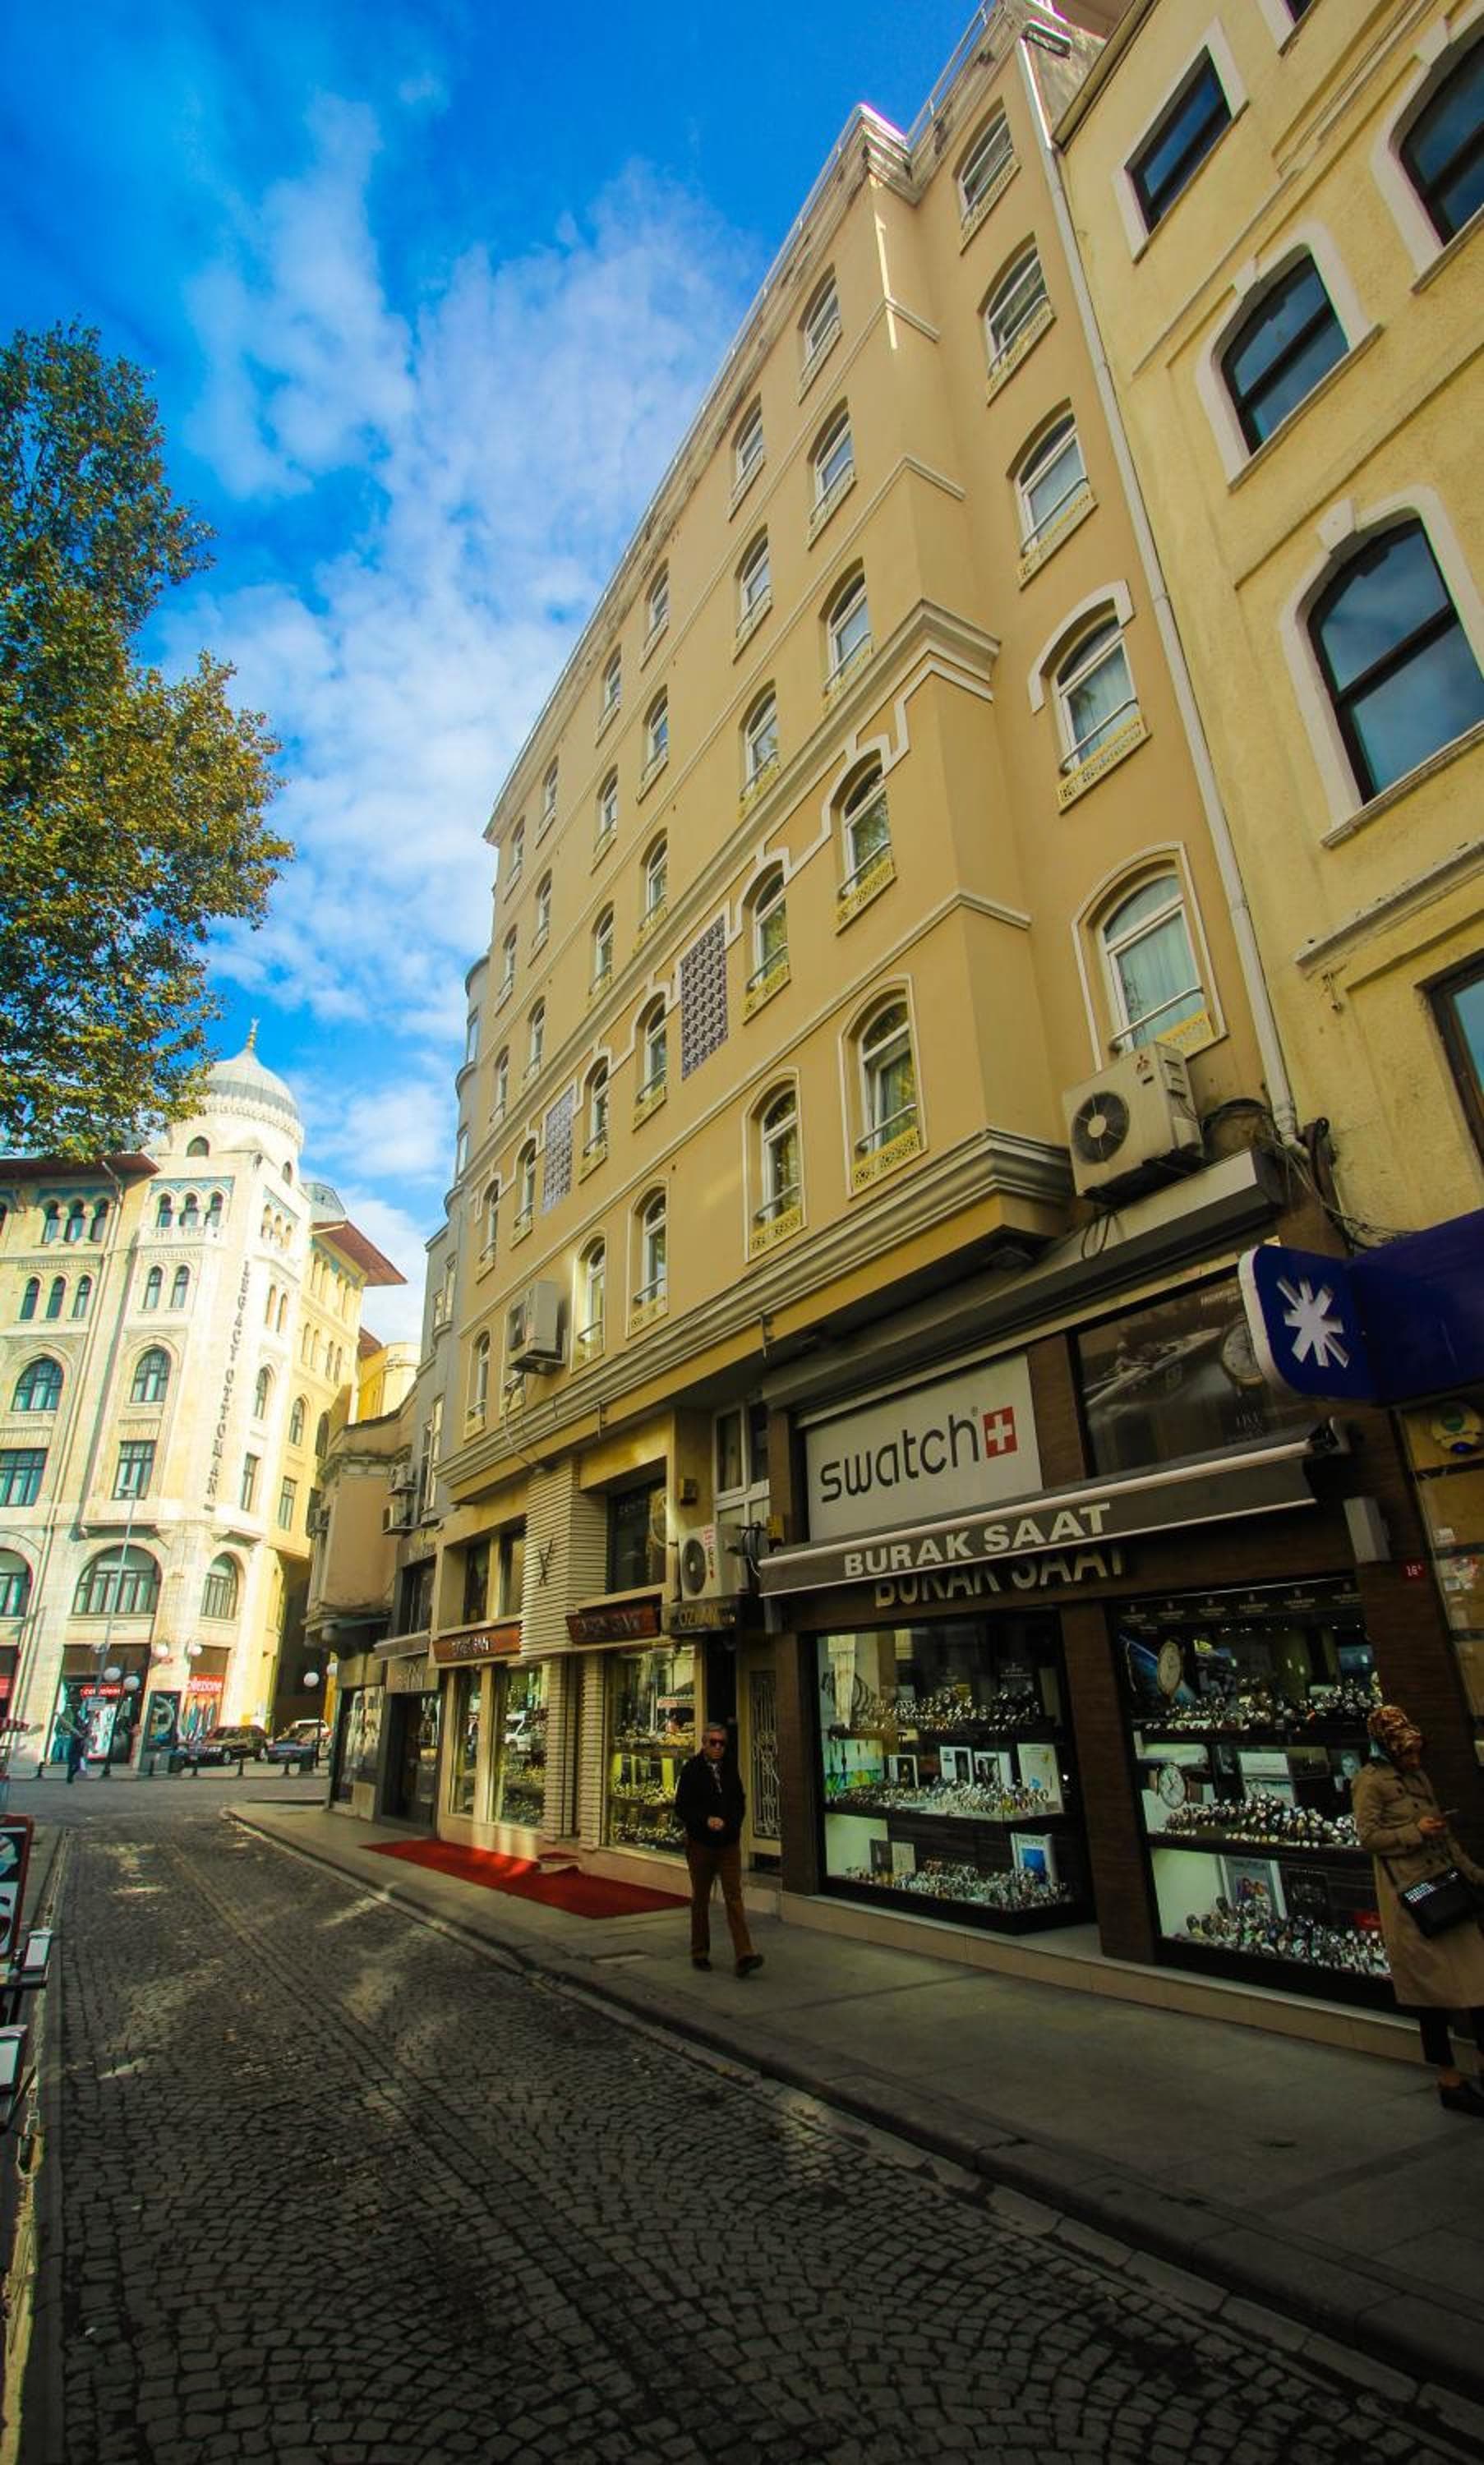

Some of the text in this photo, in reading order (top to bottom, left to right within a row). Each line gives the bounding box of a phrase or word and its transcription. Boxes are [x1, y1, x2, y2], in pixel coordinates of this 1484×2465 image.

[820, 1414, 979, 1503] swatch
[844, 1503, 1109, 1577] BURAK SAAT
